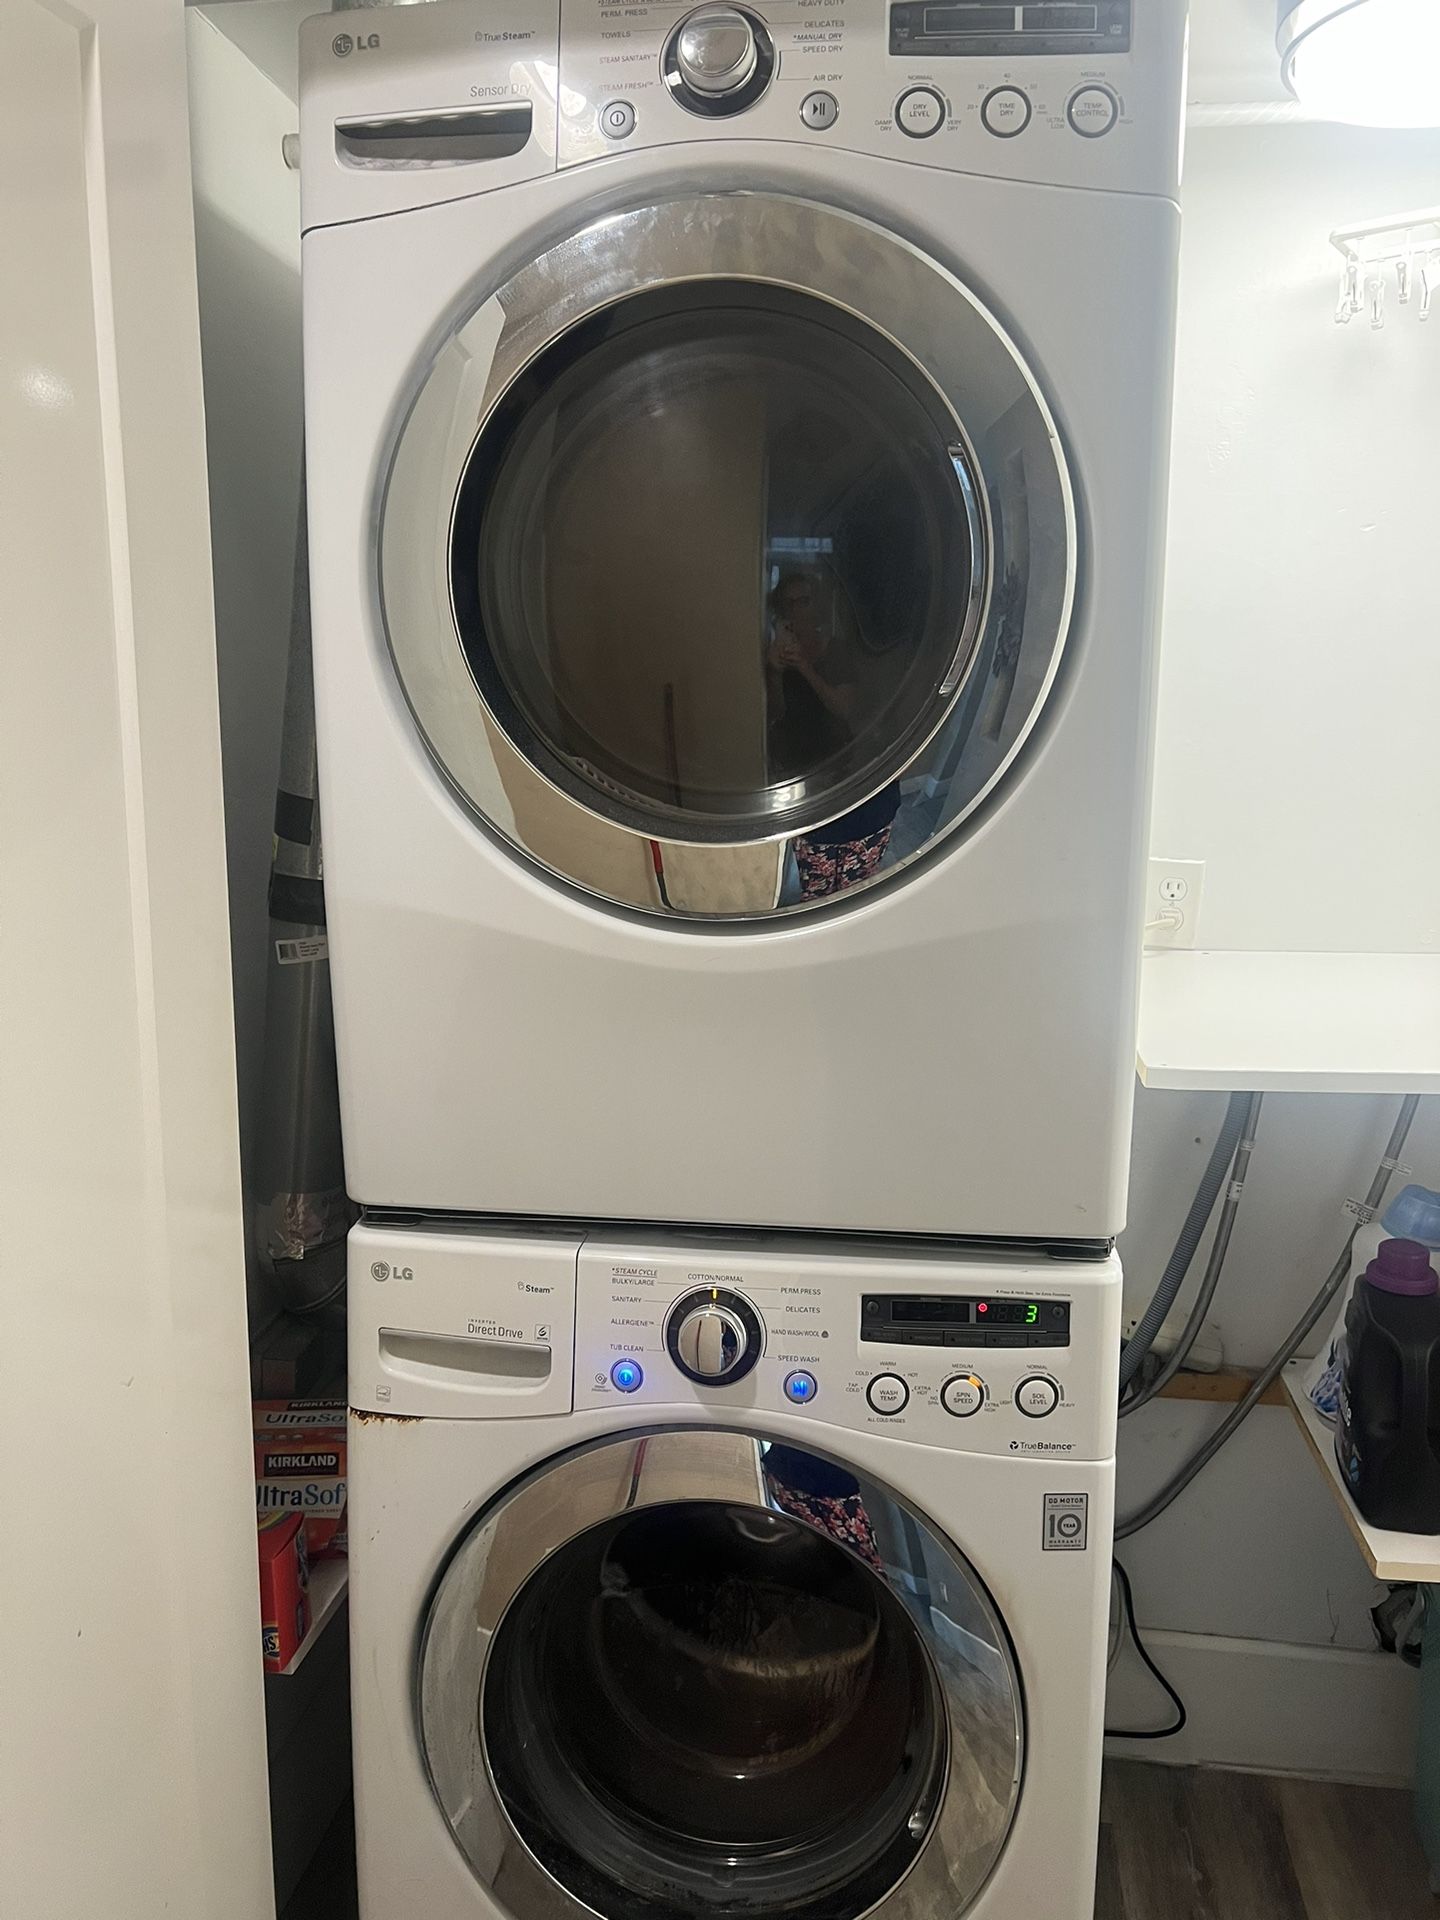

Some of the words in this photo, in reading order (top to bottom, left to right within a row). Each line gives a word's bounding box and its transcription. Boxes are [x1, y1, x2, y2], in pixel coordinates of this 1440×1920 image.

[804, 20, 845, 28] DELICATES
[601, 31, 631, 39] TOWELS
[357, 33, 381, 50] LG
[470, 85, 507, 98] Sensor
[511, 83, 532, 97] Dry
[600, 84, 622, 92] STEAM
[1076, 109, 1110, 117] CONTROL
[393, 1266, 414, 1281] LG
[688, 1274, 745, 1283] COTTON/NORMAL
[612, 1277, 655, 1287] BULKY/LARGE
[800, 1288, 821, 1296] PRESS
[785, 1306, 821, 1314] DELICATES
[1024, 1303, 1039, 1324] 3
[468, 1323, 497, 1336] Direct
[498, 1326, 523, 1338] Drive
[266, 1413, 344, 1424] UltraSo
[269, 1455, 337, 1467] KIRKLAND
[257, 1483, 346, 1507] ltraSof
[1048, 1513, 1082, 1539] 10
